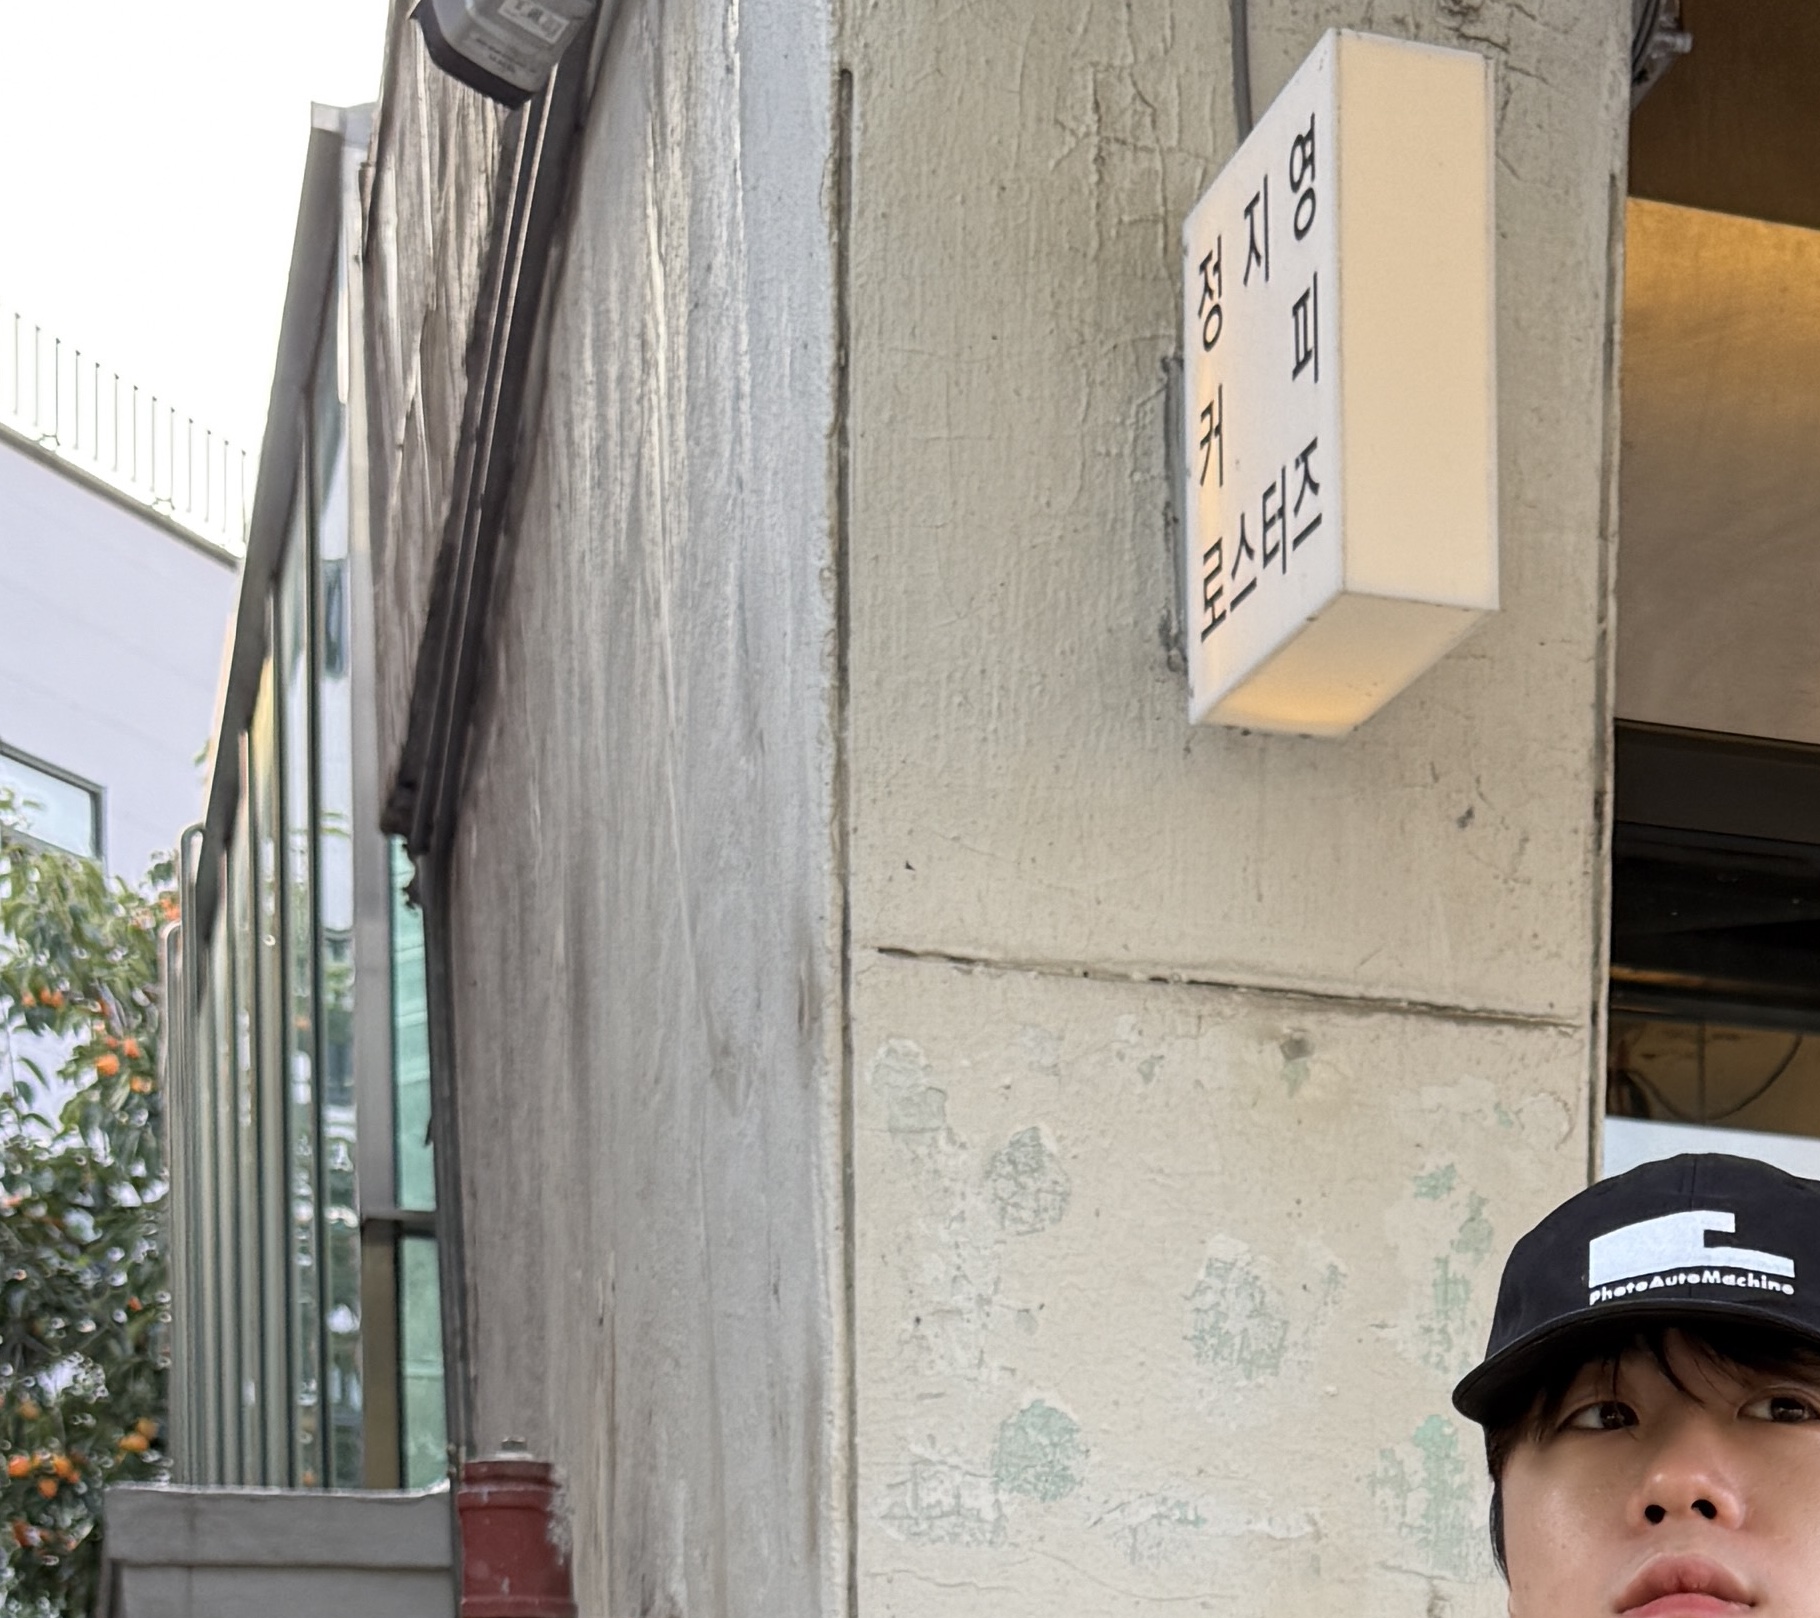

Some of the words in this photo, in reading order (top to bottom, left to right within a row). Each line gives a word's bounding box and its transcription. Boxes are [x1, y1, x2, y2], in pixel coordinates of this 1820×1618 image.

[1198, 112, 1317, 353] 정지영
[1199, 270, 1319, 488] 커피
[1201, 435, 1323, 644] 로스터즈
[1589, 1269, 1796, 1307] PhotoAutoMachine
